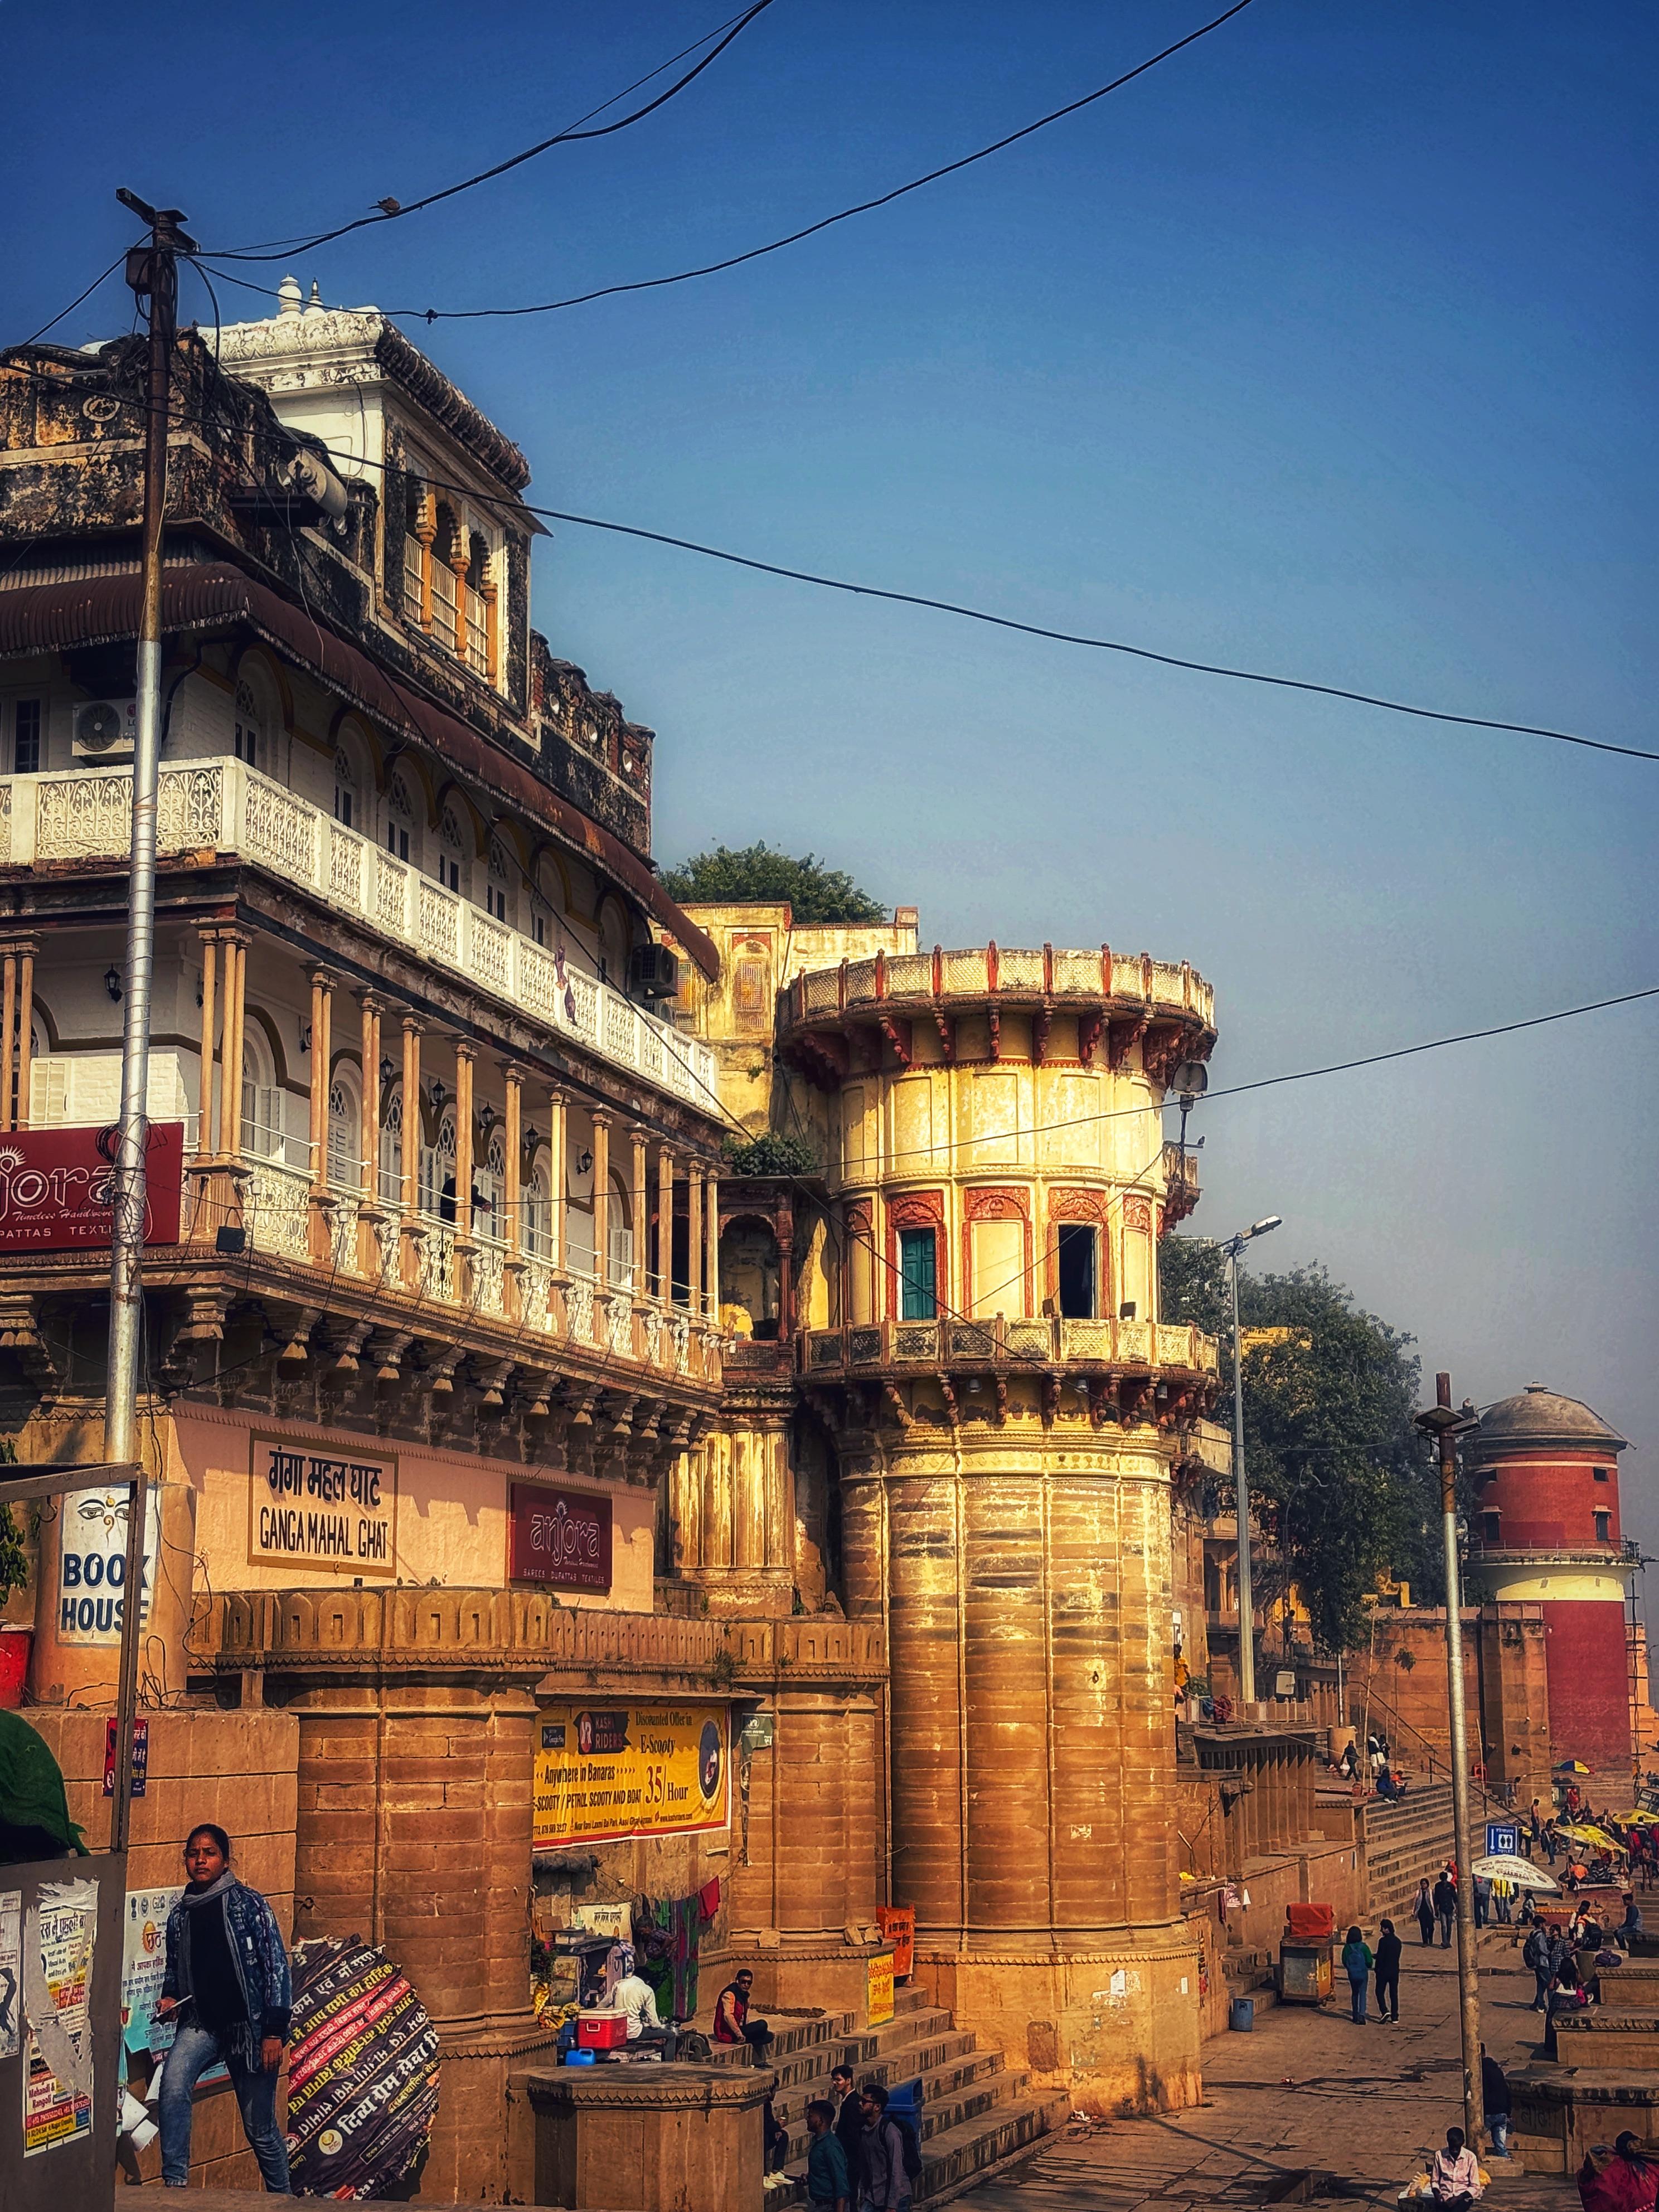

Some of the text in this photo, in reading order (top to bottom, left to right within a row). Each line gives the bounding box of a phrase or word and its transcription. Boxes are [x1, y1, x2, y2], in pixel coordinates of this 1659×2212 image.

[70, 1225, 111, 1235] TEXTI
[269, 1445, 382, 1506] गंगा महल घाट
[260, 1507, 388, 1559] GANGA MAHAL GHAT
[595, 1733, 623, 1749] RIDERS
[640, 1734, 676, 1758] E-Scooty
[544, 1762, 615, 1788] Anywhere in Banaras
[566, 1793, 588, 1809] PETROL
[589, 1791, 613, 1807] SCOOTY
[613, 1790, 626, 1804] AND
[627, 1788, 642, 1804] BOAT
[667, 1782, 688, 1801] Hour
[313, 1975, 339, 1997] एवं
[332, 1959, 354, 1980] माँ
[292, 1962, 394, 2040] में आप सभी का हार्दिक
[300, 2064, 336, 2100] स्वागत
[286, 2095, 307, 2116] एवं
[336, 2094, 379, 2136] दिव्य
[368, 2070, 403, 2104] प्रेम
